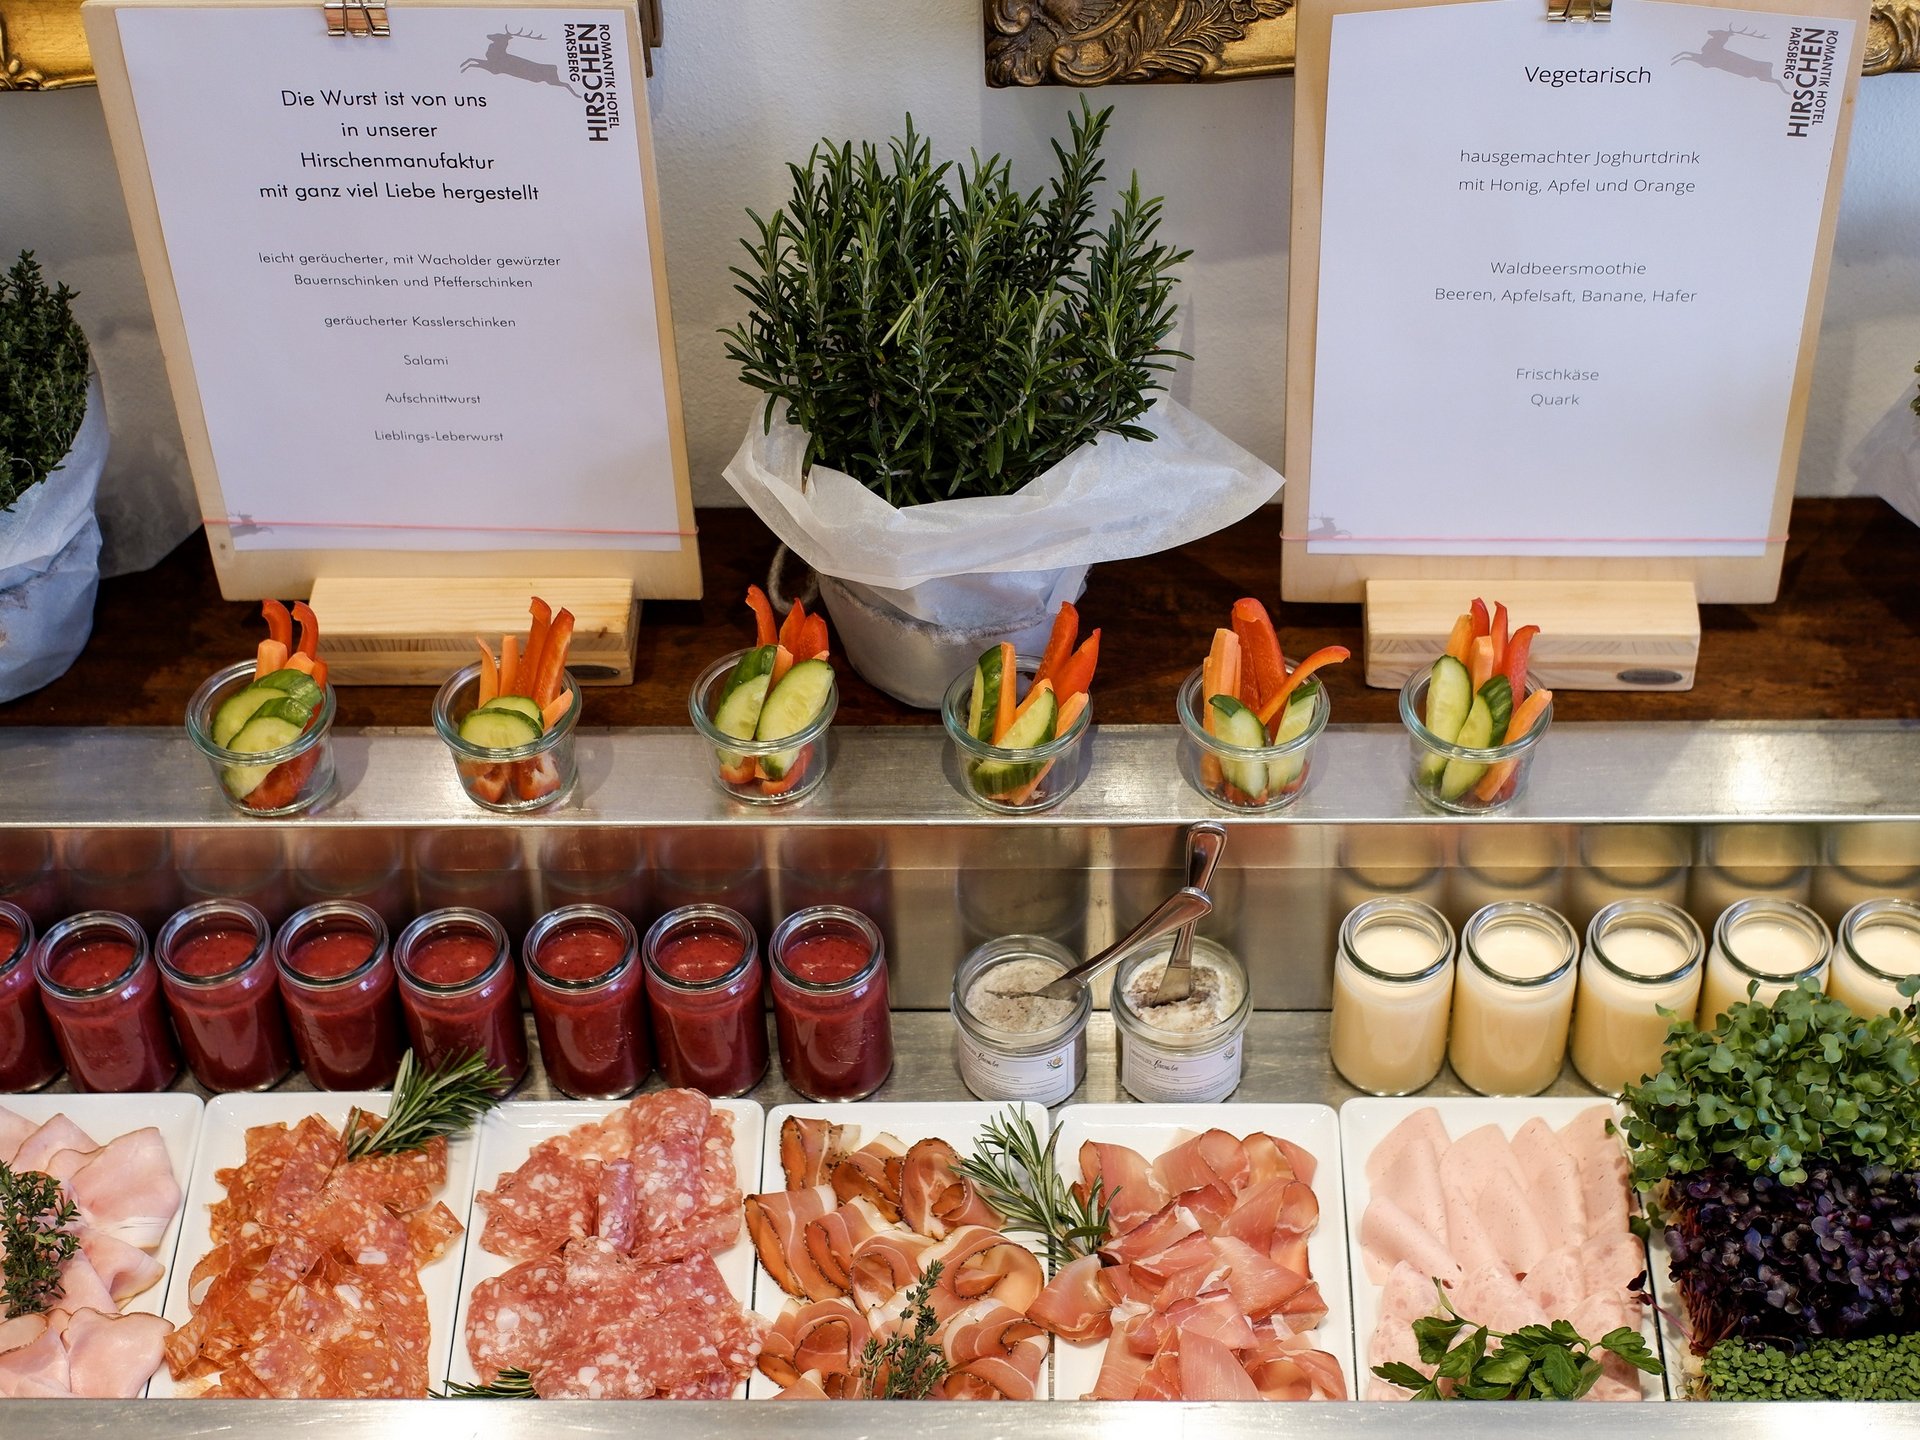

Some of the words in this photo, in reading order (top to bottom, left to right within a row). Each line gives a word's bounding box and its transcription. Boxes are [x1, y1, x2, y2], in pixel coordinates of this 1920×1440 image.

[564, 24, 580, 82] PARSBERG
[599, 24, 615, 88] ROMANTIK
[1784, 27, 1801, 79] PARSBERG
[1819, 30, 1838, 87] ROMANTIK
[577, 24, 608, 141] HIRSCHEN
[1524, 65, 1652, 88] Vegetarisch
[1787, 28, 1825, 137] HIRSCHEN
[281, 89, 315, 107] Die
[319, 89, 378, 107] Wurst
[384, 90, 405, 107] ist
[410, 95, 447, 107] von
[454, 95, 487, 108] uns
[1812, 90, 1827, 125] HOTEL
[606, 92, 619, 128] HOTEL
[340, 122, 359, 137] in
[365, 125, 438, 138] unserer
[300, 150, 495, 170] Hirschenmanufaktur
[1459, 149, 1591, 167] hausgemachter
[1592, 150, 1701, 168] Joghurtdrink
[259, 182, 289, 199] mit
[294, 187, 342, 202] ganz
[345, 181, 379, 198] viel
[385, 181, 436, 199] Liebe
[441, 182, 540, 204] hergestellt
[1458, 178, 1485, 192] mit
[1490, 178, 1542, 196] Honig,
[1546, 178, 1591, 196] Apfel
[1595, 178, 1629, 192] und
[1633, 178, 1696, 196] Orange
[258, 251, 295, 264] leicht
[298, 252, 389, 267] geräucherter,
[393, 254, 414, 265] mit
[417, 253, 492, 266] Wacholder
[496, 255, 561, 269] gewürzter
[1490, 261, 1647, 276] Waldbeersmoothie
[293, 273, 399, 288] Bauernschinken
[403, 275, 429, 288] und
[433, 275, 533, 288] Pfefferschinken
[1435, 287, 1496, 302] Beeren,
[1500, 288, 1576, 305] Apfelsaft,
[1581, 289, 1647, 304] Banane,
[1652, 289, 1697, 303] Hafer
[324, 314, 408, 328] geräucherter
[412, 315, 516, 328] Kasslerschinken
[403, 354, 449, 366] Salami
[1516, 367, 1600, 381] Frischkäse
[385, 392, 481, 404] Aufschnittwurst
[1530, 393, 1580, 407] Quark
[374, 429, 504, 444] Lieblings-Leberwurst
